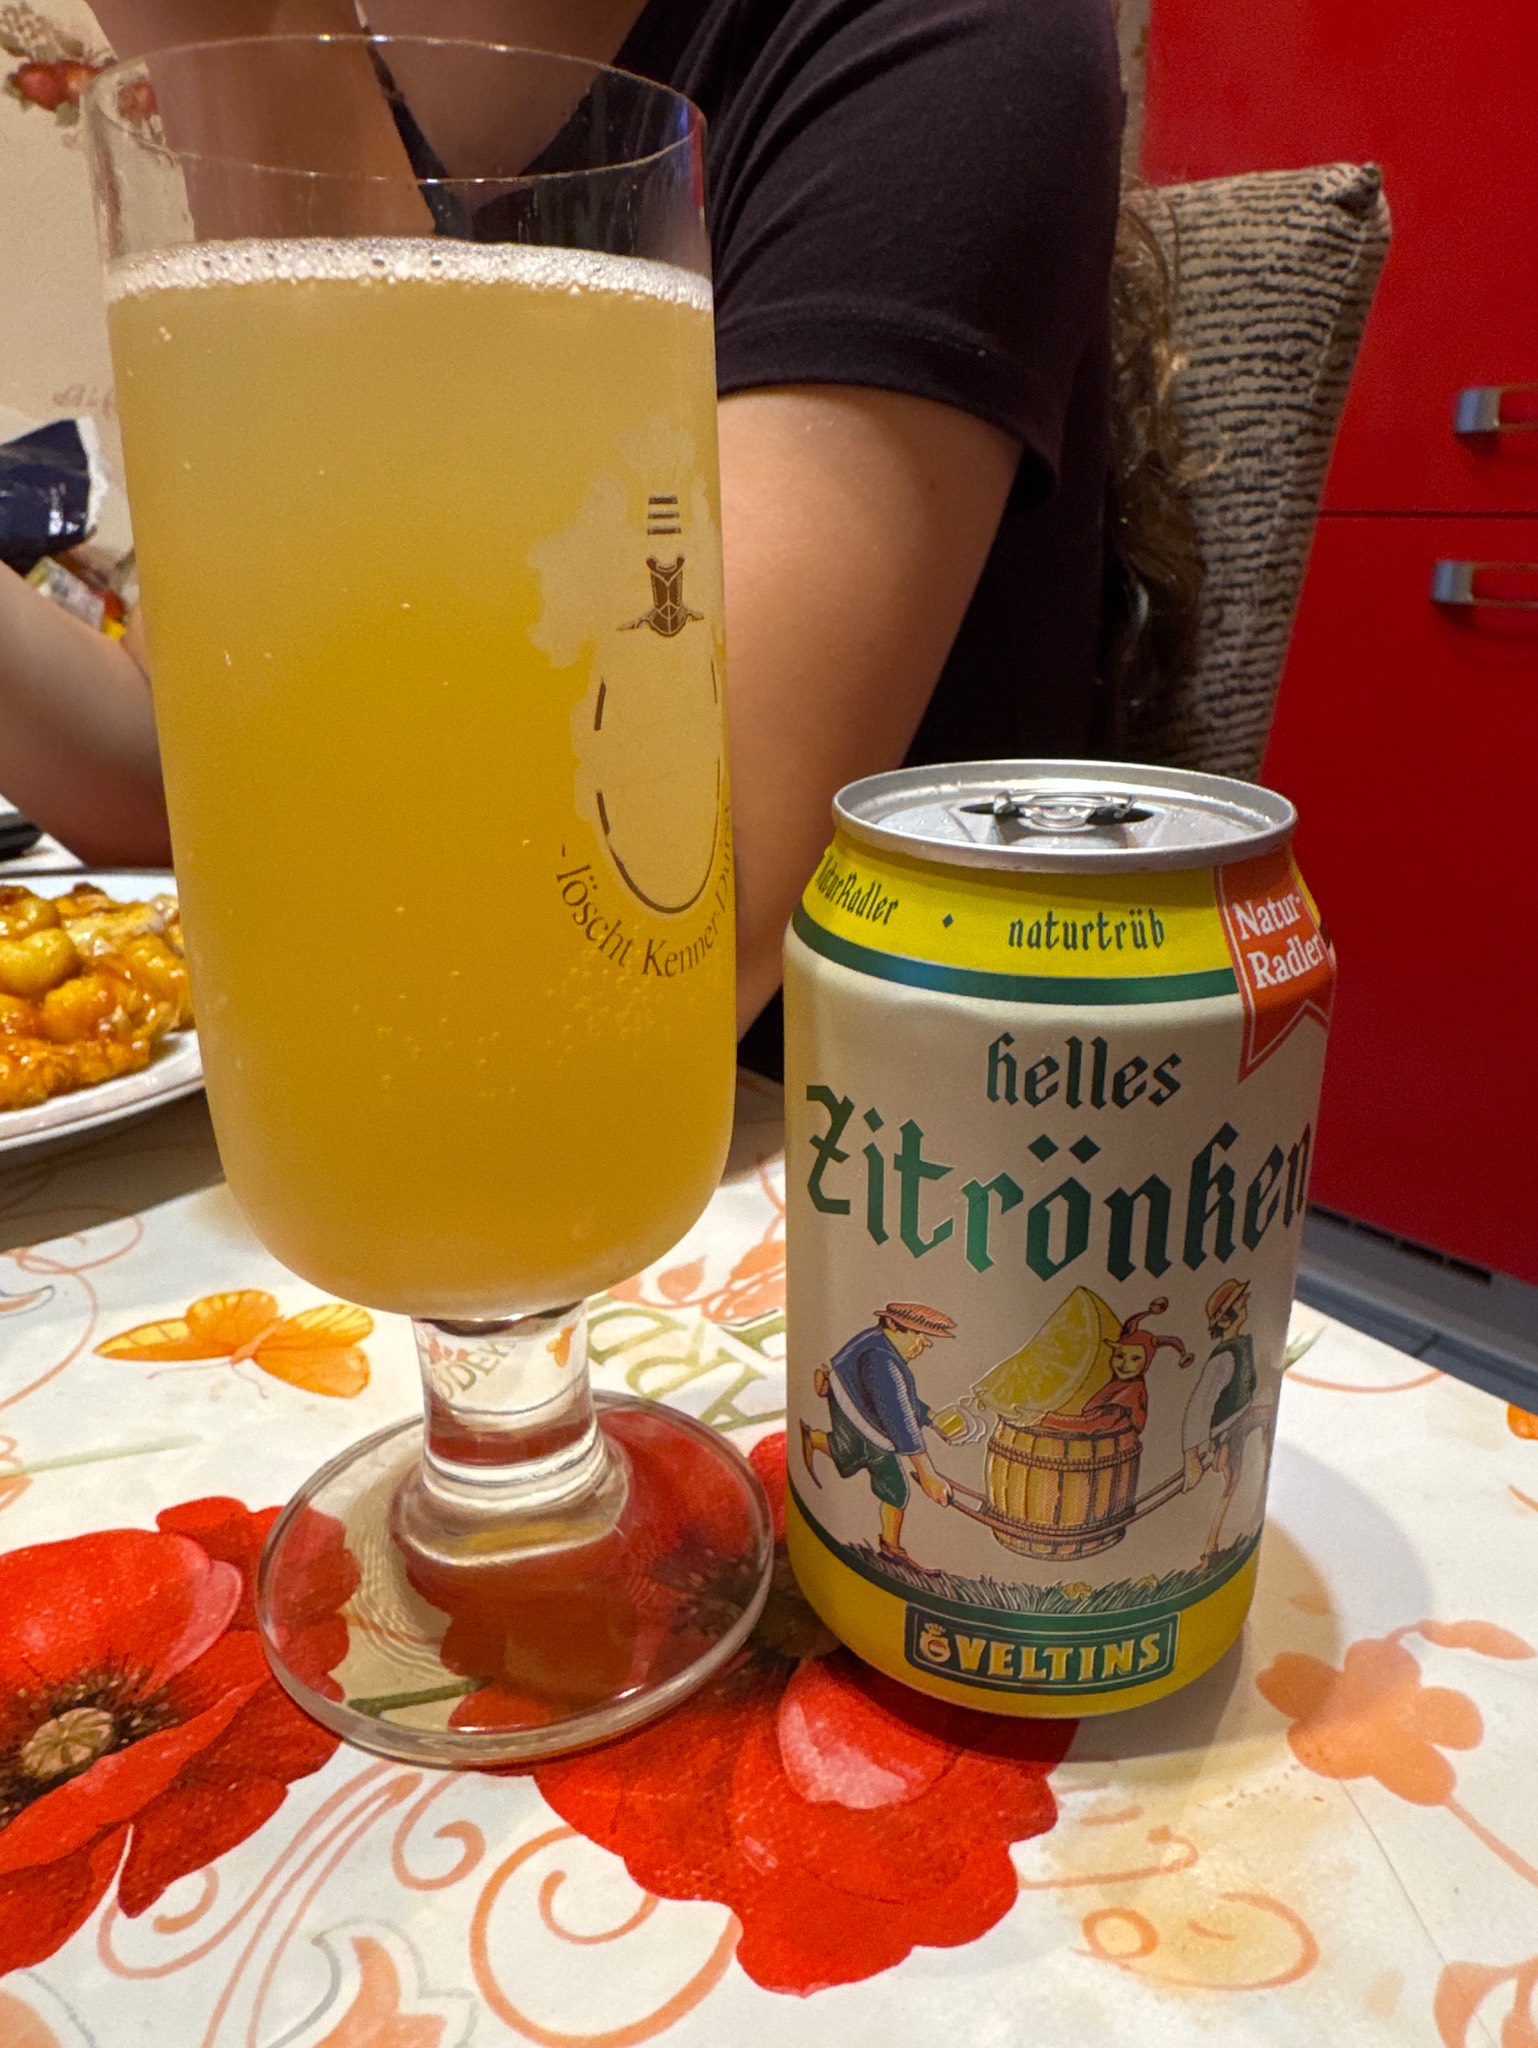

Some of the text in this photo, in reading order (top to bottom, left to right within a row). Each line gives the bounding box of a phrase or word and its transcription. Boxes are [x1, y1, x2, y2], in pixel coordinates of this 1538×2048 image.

[556, 865, 634, 968] löscht
[1008, 907, 1165, 951] naturtrüb
[1232, 892, 1300, 941] Natur-
[1247, 933, 1325, 990] Radler
[987, 1032, 1182, 1110] helles
[954, 1633, 1161, 1682] VELTINS
